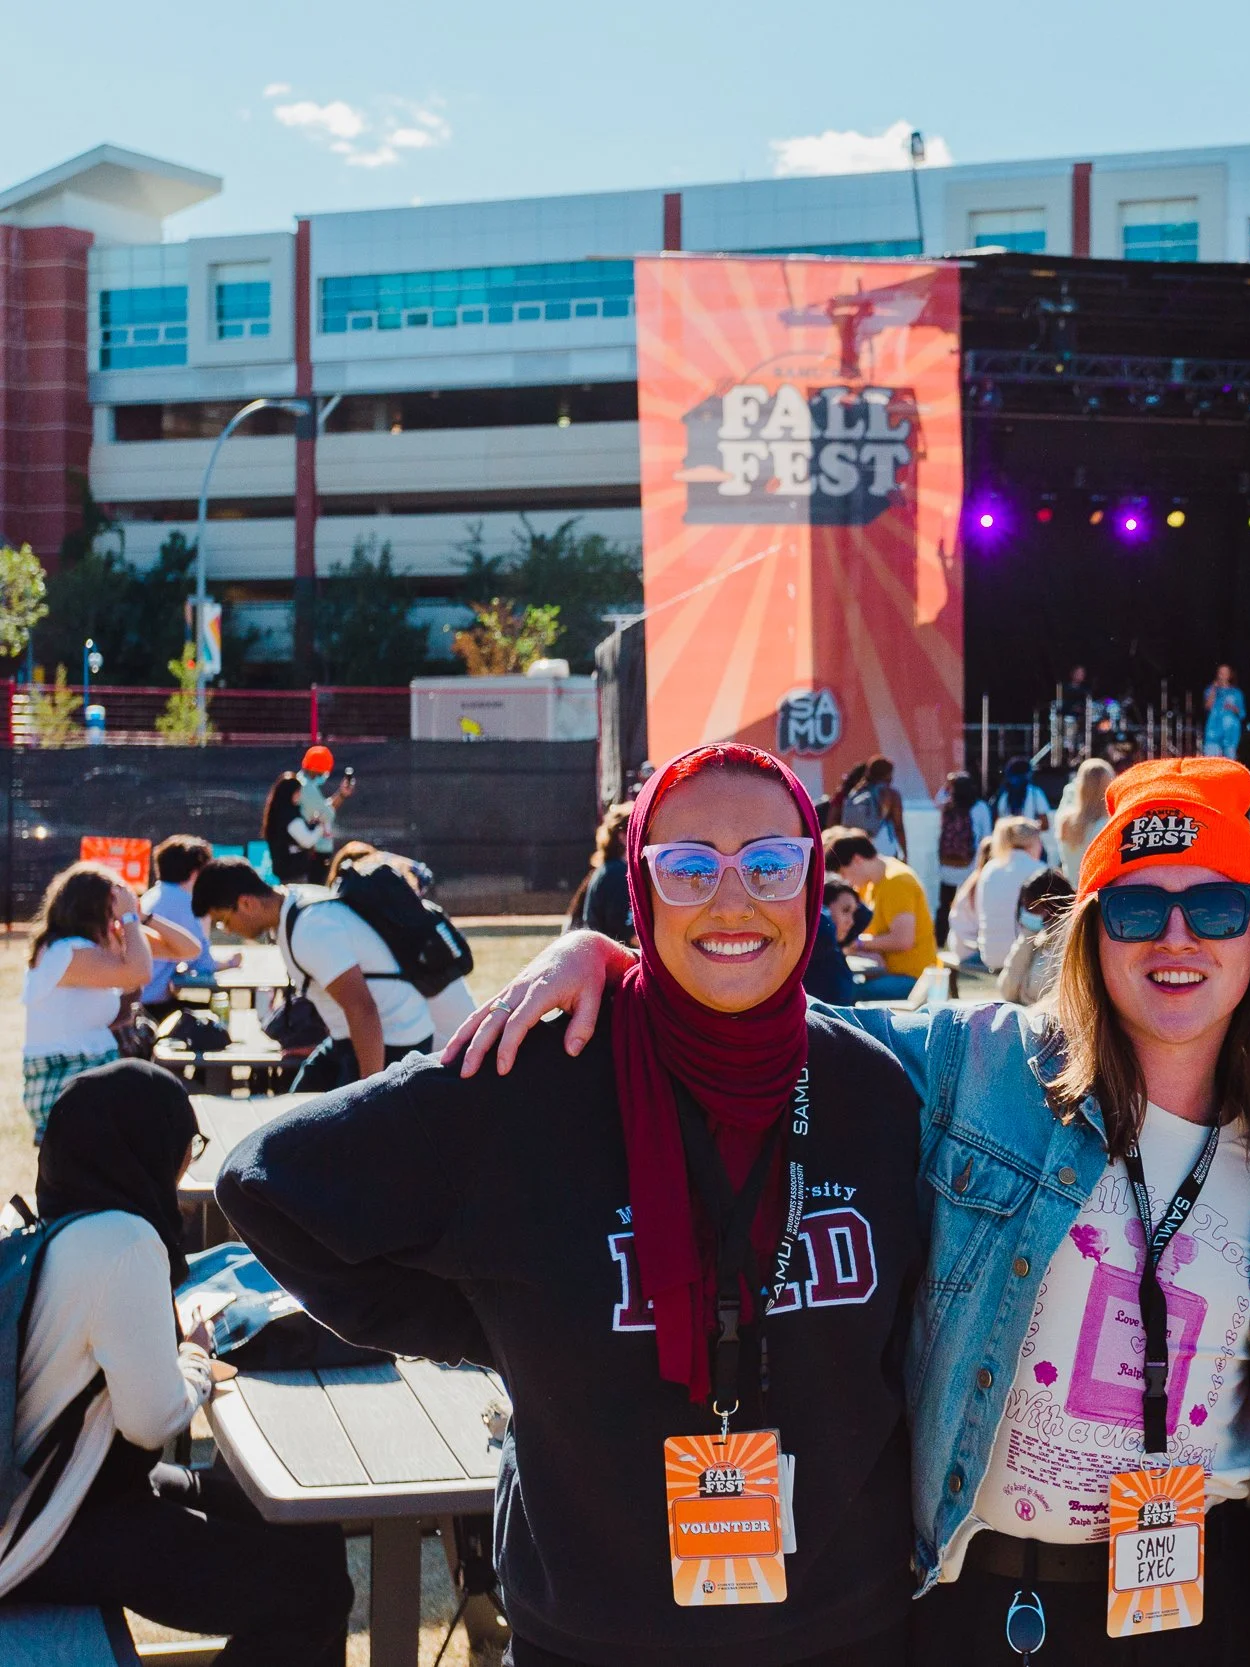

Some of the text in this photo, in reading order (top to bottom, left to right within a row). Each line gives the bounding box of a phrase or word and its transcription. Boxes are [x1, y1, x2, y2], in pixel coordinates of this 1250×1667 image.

[718, 384, 910, 439] FALL
[717, 441, 911, 497] FEST
[787, 689, 839, 718] SA
[787, 716, 840, 745] MU
[1131, 815, 1199, 834] FALL
[1130, 831, 1198, 852] FEST
[793, 1163, 804, 1236] MACEWAN UNIVERSITY
[1152, 1196, 1191, 1246] SAMU
[1114, 1309, 1140, 1327] Love
[1005, 1388, 1064, 1443] With
[1068, 1421, 1089, 1444] a
[705, 1468, 746, 1481] FALL
[705, 1480, 746, 1493] FEST
[1068, 1500, 1109, 1514] Brought
[1143, 1500, 1177, 1515] FALL
[680, 1520, 770, 1534] VOLUNTEER
[1069, 1517, 1092, 1527] Ralph
[1143, 1512, 1177, 1526] FEST
[1136, 1534, 1176, 1560] SAMU
[1137, 1556, 1176, 1583] EXEC
